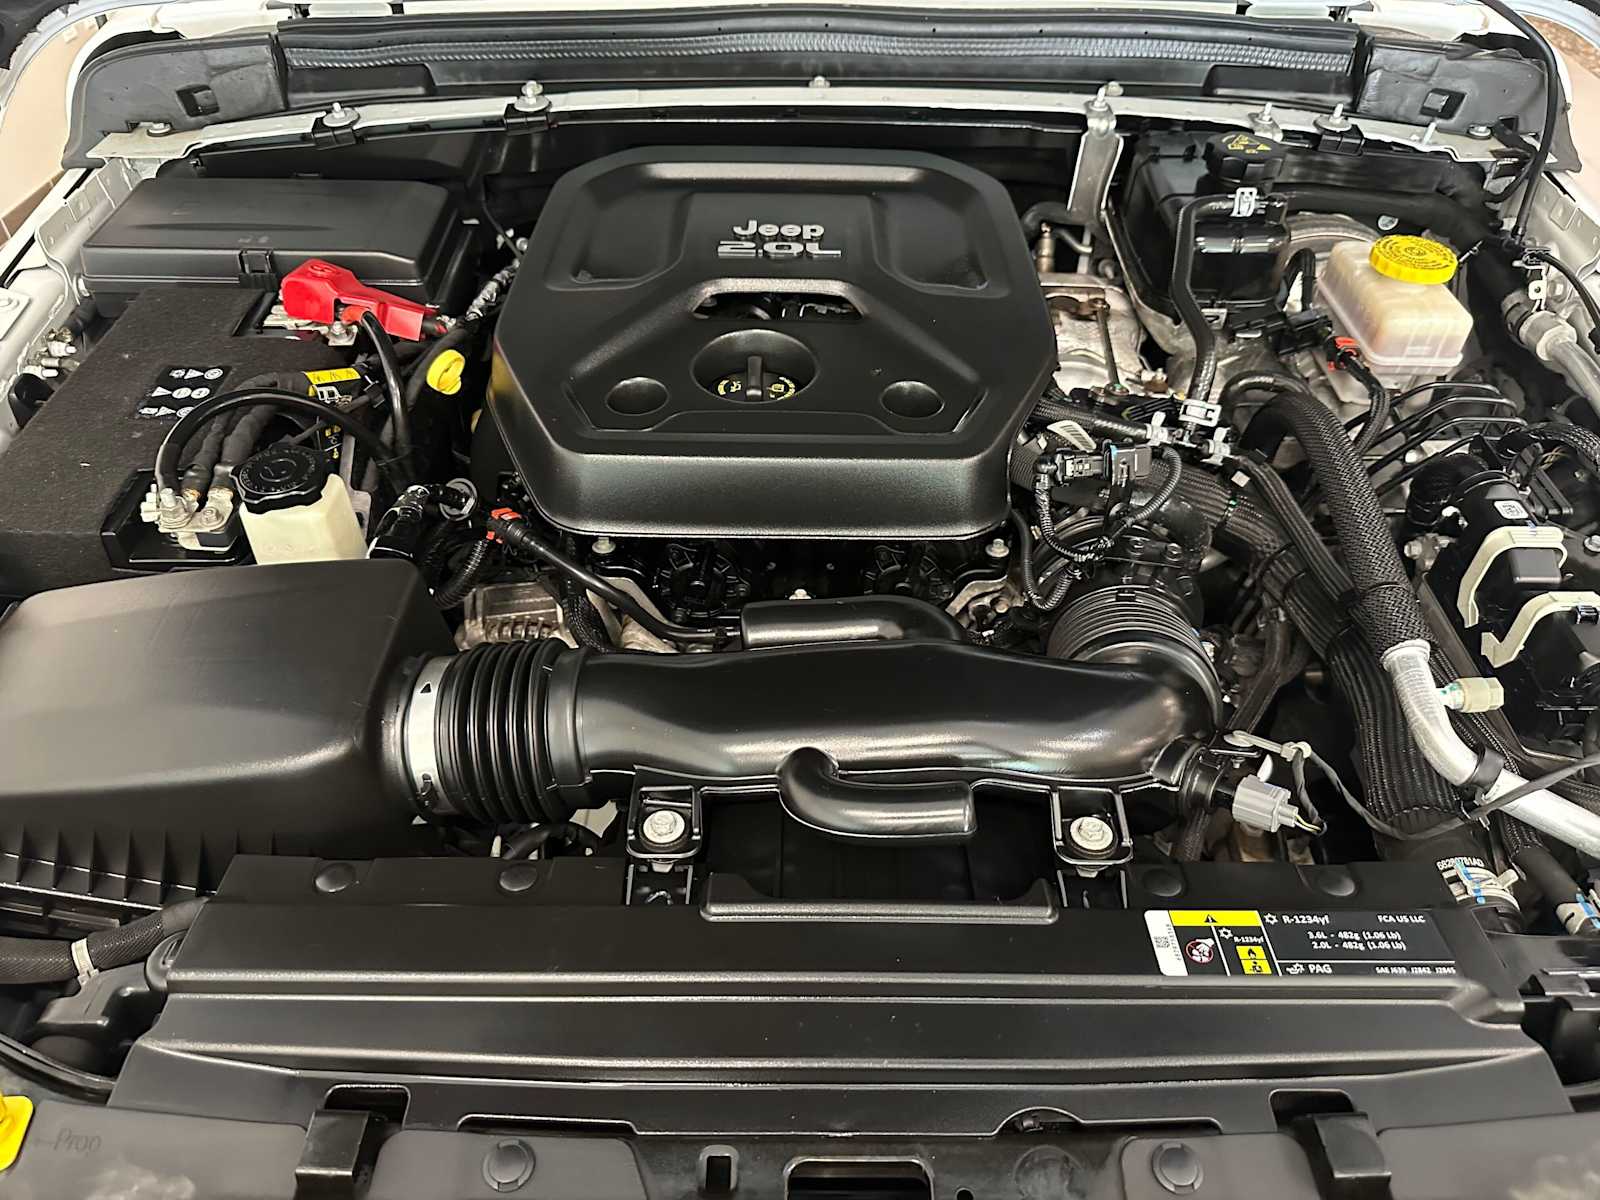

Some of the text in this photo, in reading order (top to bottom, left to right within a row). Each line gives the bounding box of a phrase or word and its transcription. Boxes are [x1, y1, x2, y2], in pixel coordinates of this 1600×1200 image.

[733, 219, 825, 240] Jeep
[717, 240, 842, 257] 2.0L
[1282, 914, 1330, 925] R-1234yf
[1377, 914, 1426, 923] FCA US LLC
[1307, 931, 1328, 940] 3.6L
[1338, 931, 1361, 941] 482g
[1312, 941, 1332, 950] 2.0L
[1342, 941, 1366, 951] 482g
[1308, 964, 1332, 974] PAG
